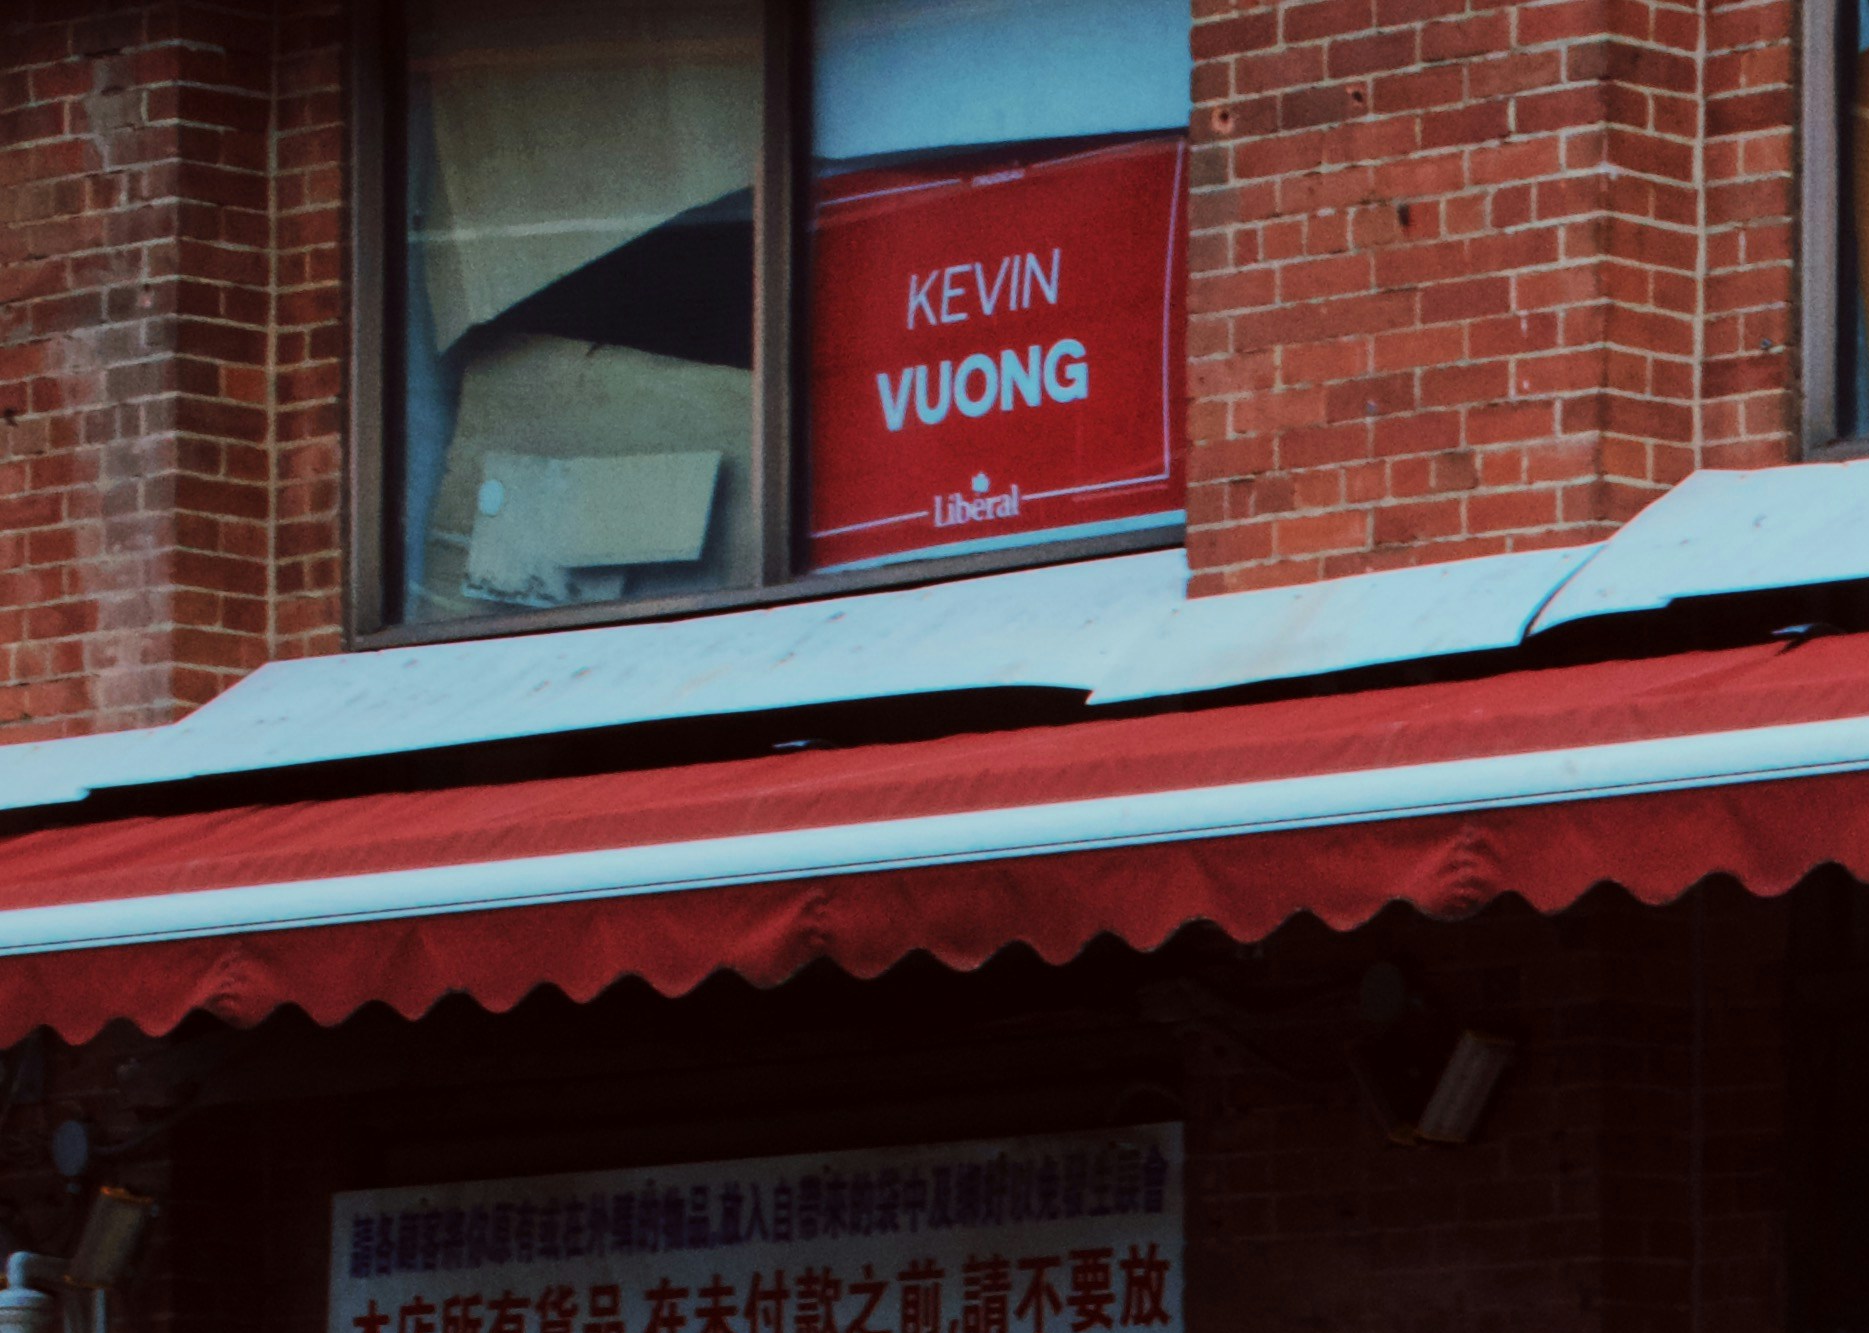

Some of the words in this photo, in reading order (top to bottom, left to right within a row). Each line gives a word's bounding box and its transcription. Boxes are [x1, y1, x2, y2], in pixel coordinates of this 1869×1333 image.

[906, 247, 1061, 330] KEVIN
[875, 338, 1089, 432] VUONG
[934, 483, 1020, 528] Liberal
